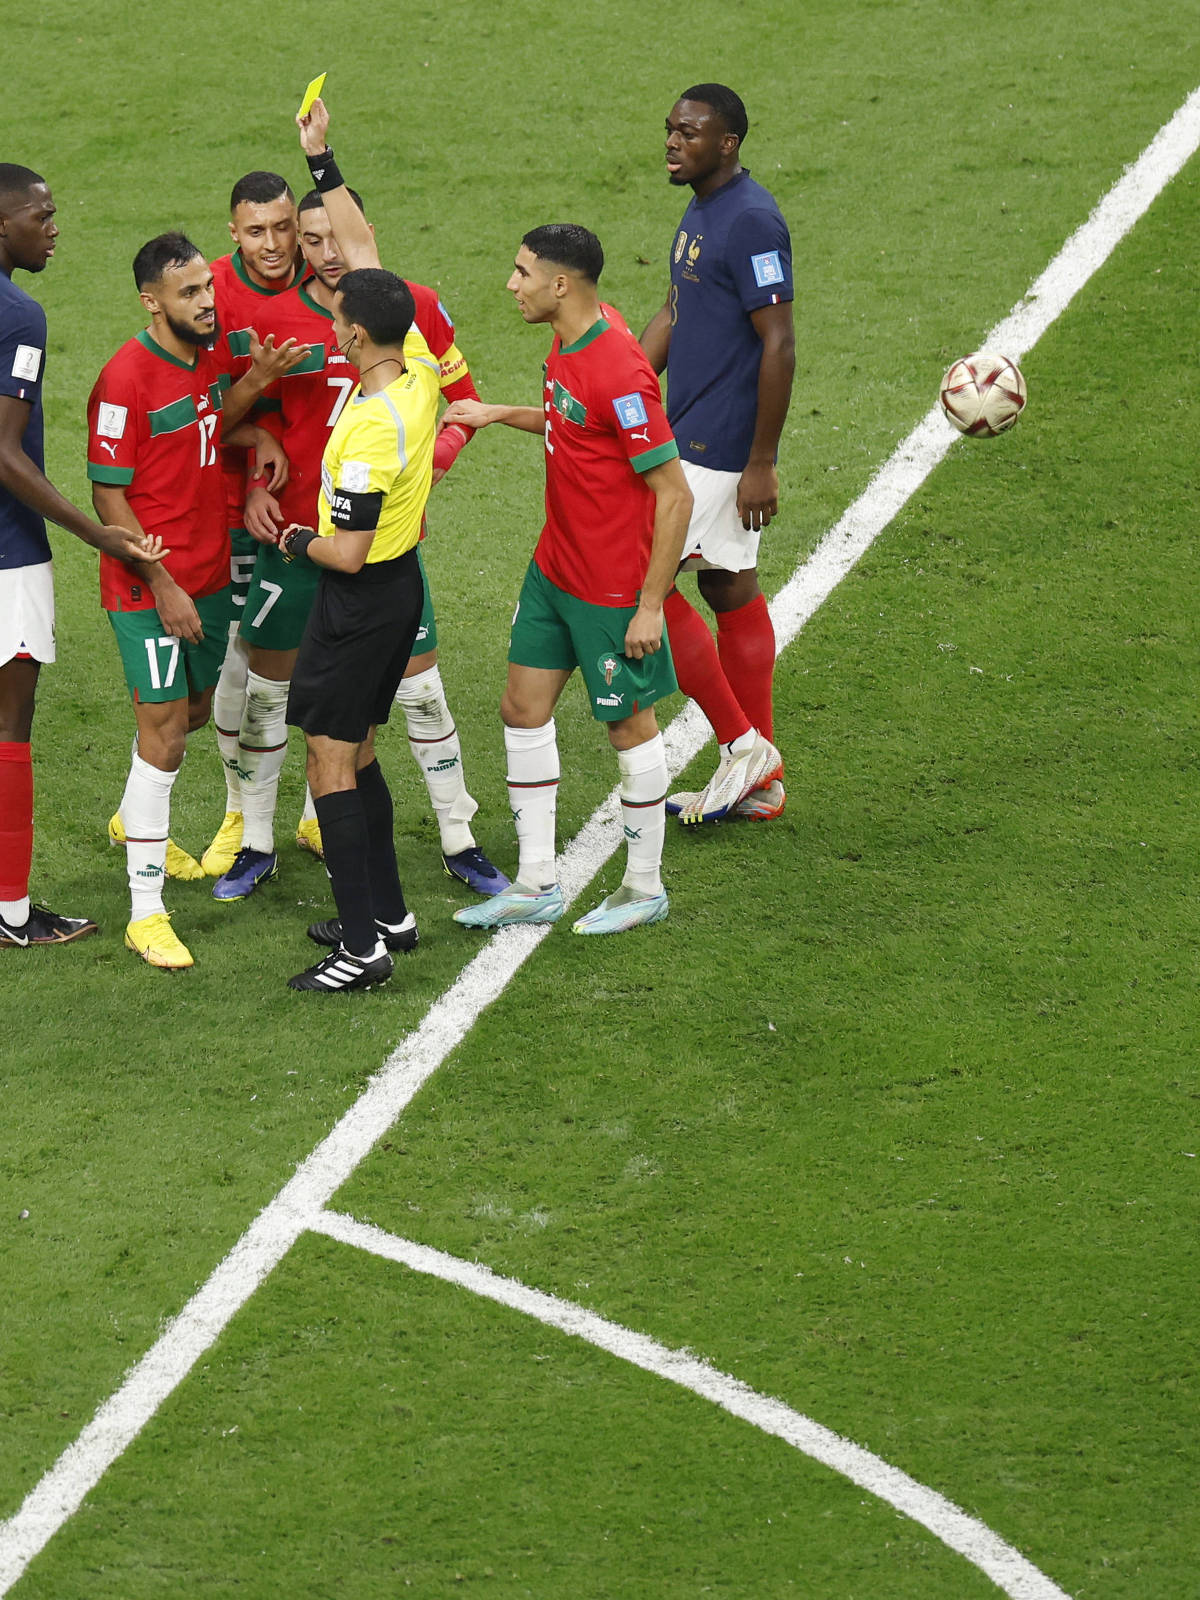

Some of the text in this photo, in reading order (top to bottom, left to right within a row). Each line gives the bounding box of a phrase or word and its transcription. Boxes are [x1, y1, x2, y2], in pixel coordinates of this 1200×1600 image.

[326, 377, 354, 427] 7
[198, 414, 218, 468] 17
[331, 495, 352, 511] IFA
[337, 512, 350, 520] ONE
[251, 579, 284, 628] 7
[144, 635, 180, 689] 17
[596, 696, 620, 707] PUMA
